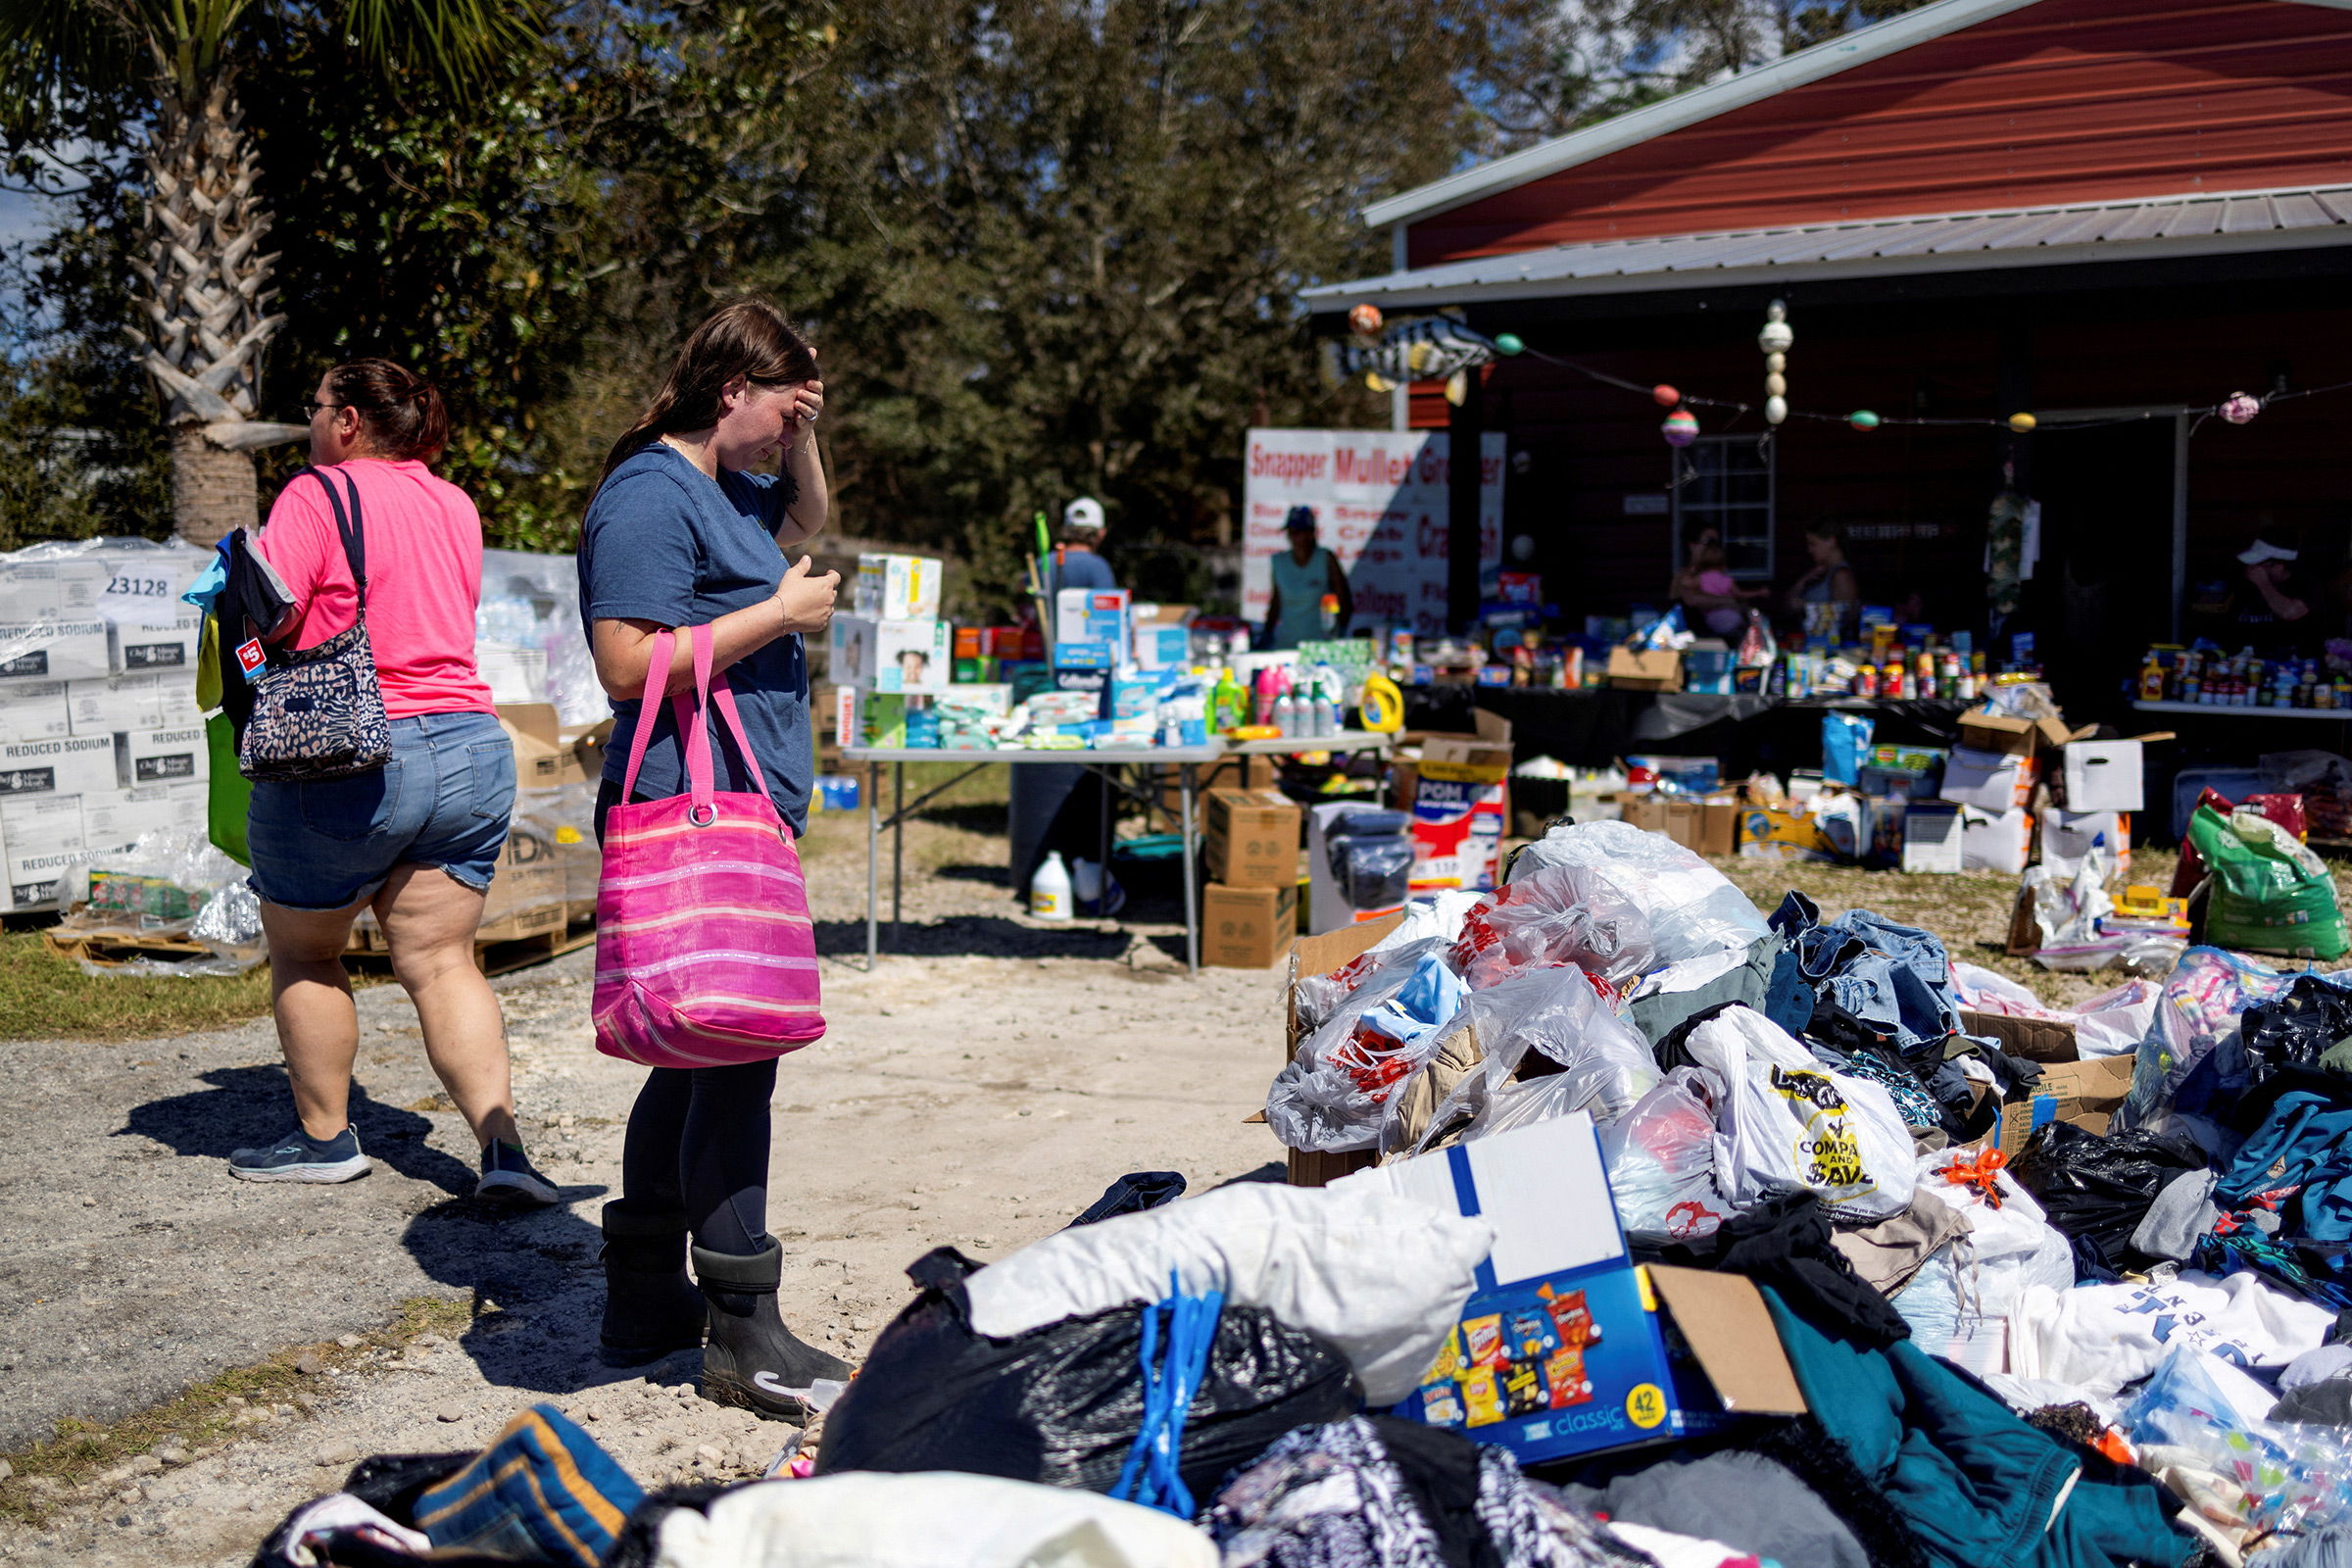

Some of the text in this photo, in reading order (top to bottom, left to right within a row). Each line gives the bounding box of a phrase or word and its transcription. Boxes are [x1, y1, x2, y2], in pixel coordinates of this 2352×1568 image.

[1251, 444, 1500, 486] Snapper Mullet Grer
[106, 576, 168, 598] 23128
[58, 622, 104, 636] SODIUM
[242, 645, 261, 663] $5
[152, 730, 201, 745] REDUCED
[6, 737, 111, 759] REDUCED SODIUM
[23, 854, 76, 871] REDUCED
[2030, 1082, 2052, 1093] AGILE
[1799, 1141, 1859, 1157] COMPA
[1635, 1391, 1655, 1412] 42
[1555, 1404, 1622, 1435] classic
